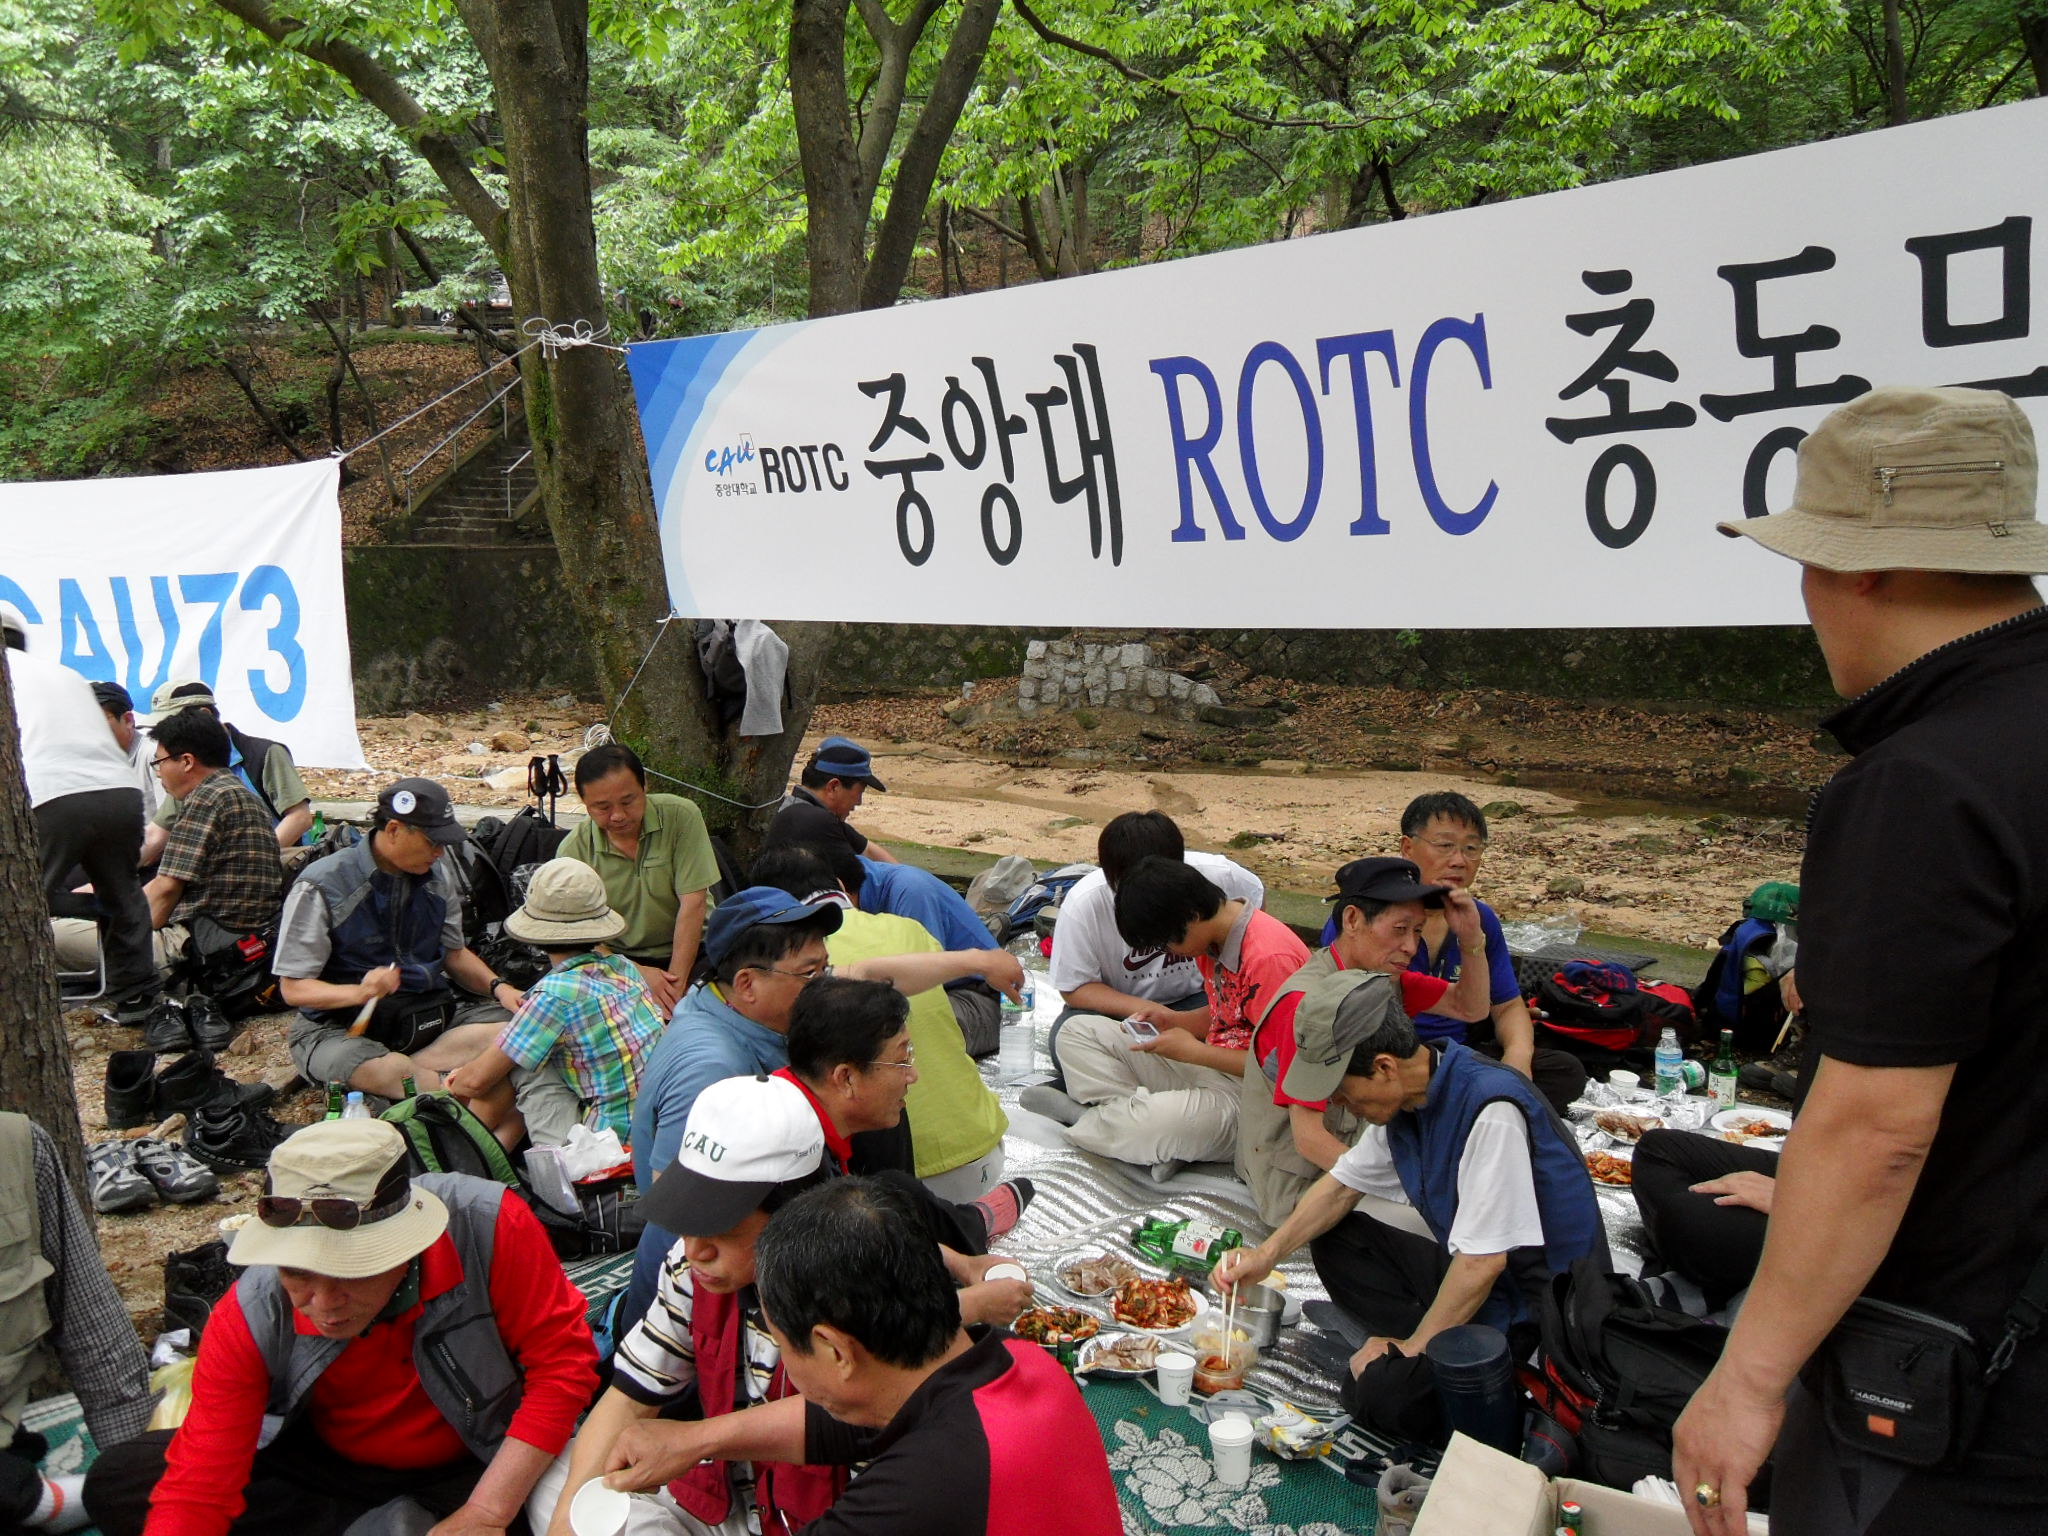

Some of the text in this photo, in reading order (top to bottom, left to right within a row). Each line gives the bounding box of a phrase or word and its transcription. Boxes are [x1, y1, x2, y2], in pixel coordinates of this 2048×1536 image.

[857, 343, 1124, 567] 중앙대
[1148, 312, 1500, 543] ROTC
[758, 442, 850, 494] ROTC
[714, 482, 758, 498] 중앙대학교
[684, 1131, 728, 1163] CAU
